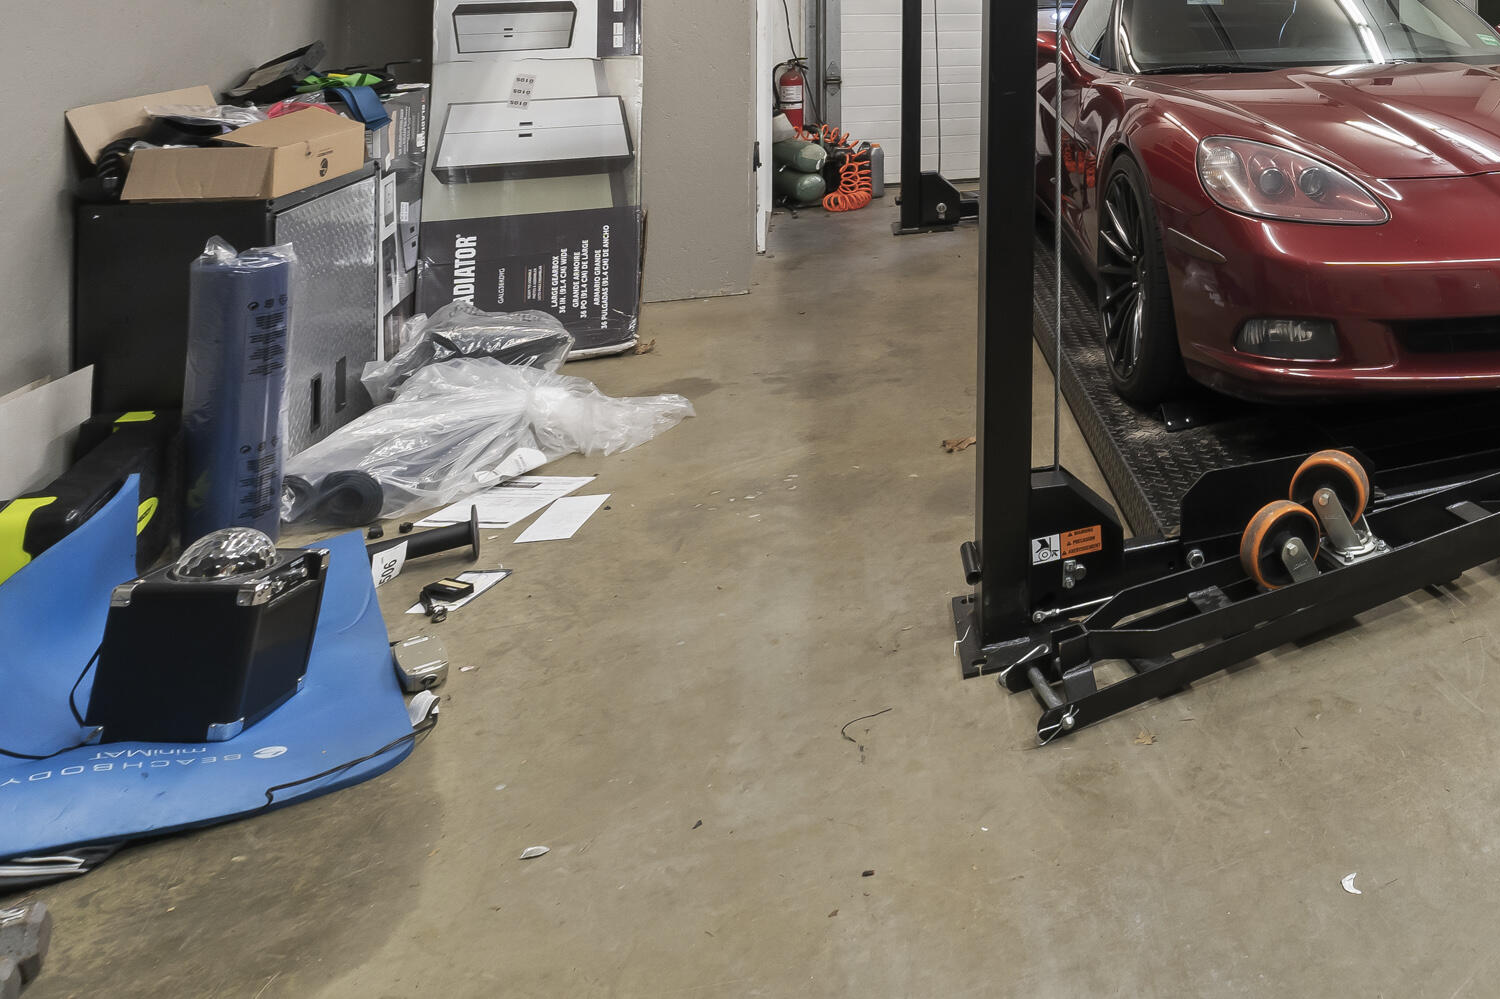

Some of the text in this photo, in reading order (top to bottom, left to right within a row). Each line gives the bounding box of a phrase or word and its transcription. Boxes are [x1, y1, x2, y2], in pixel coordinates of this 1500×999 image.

[603, 249, 609, 258] DE
[582, 261, 588, 269] DE
[453, 236, 477, 306] ADIATOR
[580, 300, 587, 309] PO
[580, 310, 587, 318] 36
[90, 747, 207, 760] miniMAT
[0, 753, 242, 787] BEACHBODY
